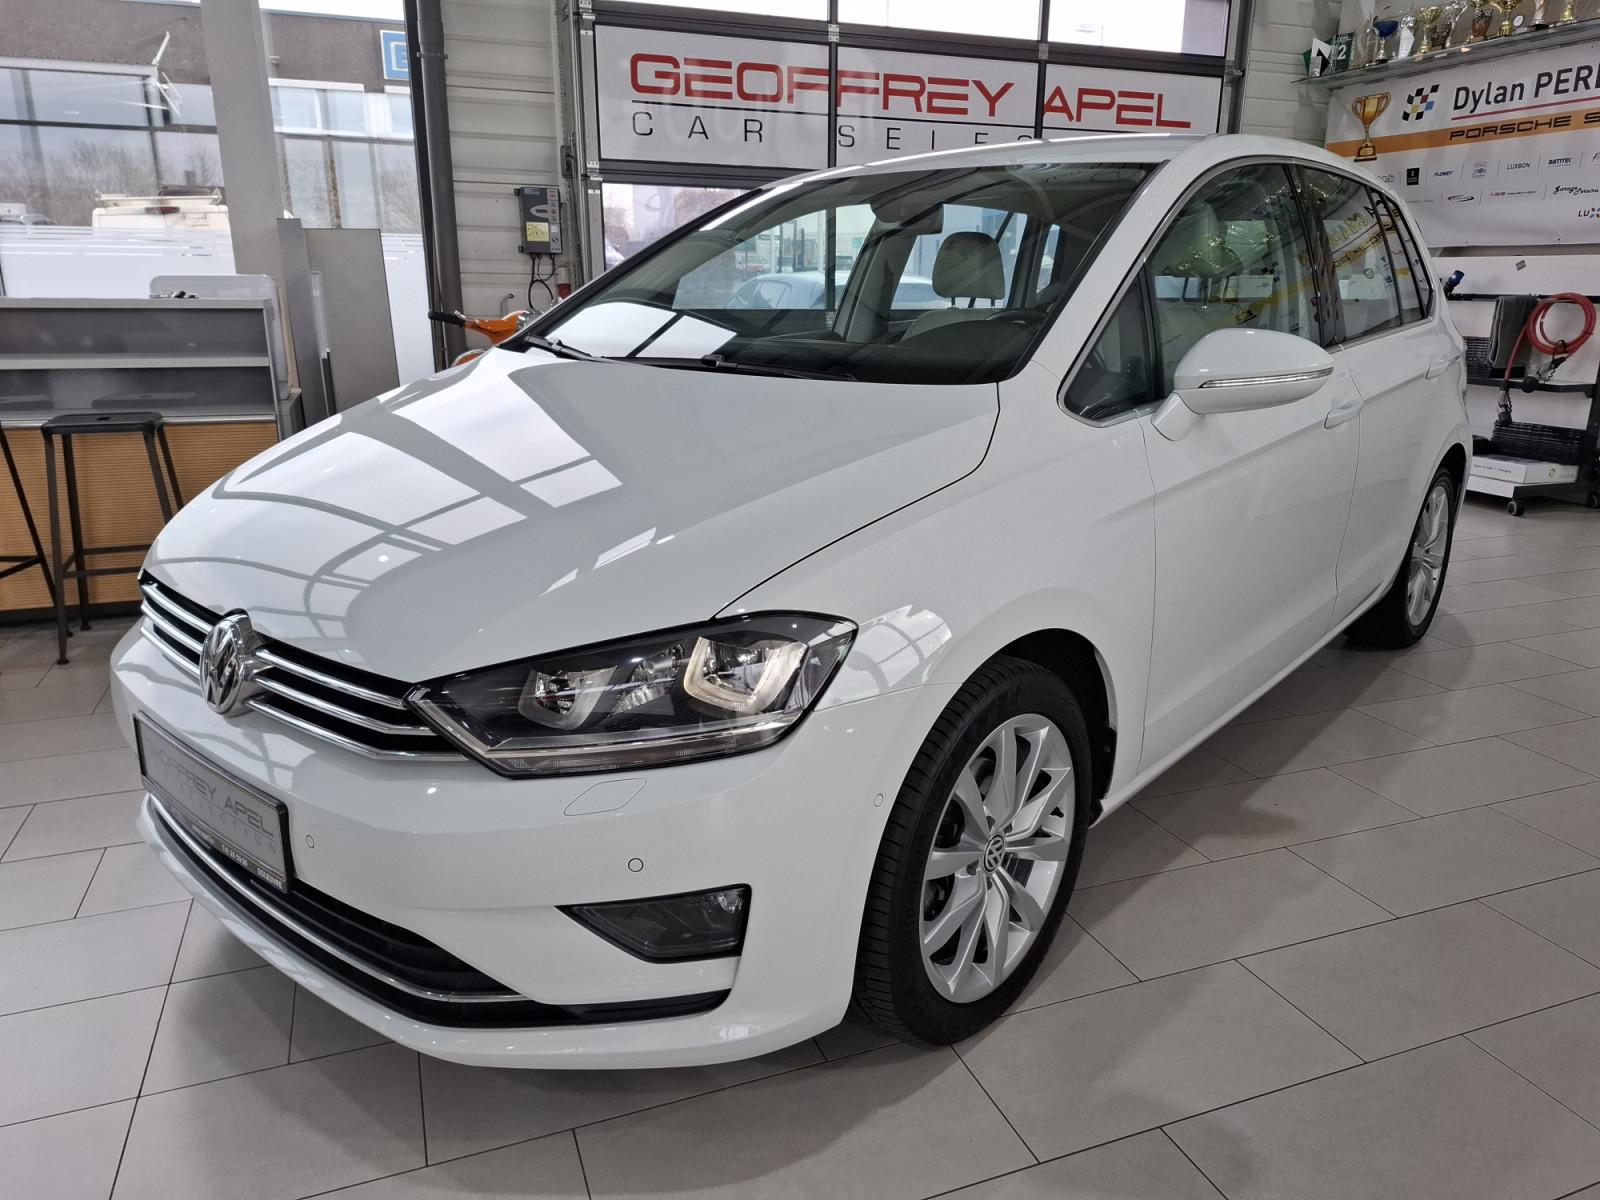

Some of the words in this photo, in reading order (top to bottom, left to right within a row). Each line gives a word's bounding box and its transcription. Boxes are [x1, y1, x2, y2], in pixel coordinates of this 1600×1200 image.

[630, 52, 1015, 117] GEOFFREY
[1043, 85, 1191, 128] APEL
[1453, 81, 1525, 114] Dylan
[1534, 63, 1600, 98] PER
[632, 111, 763, 143] CAR
[1449, 115, 1572, 141] PORSCHE
[225, 797, 275, 838] APEL
